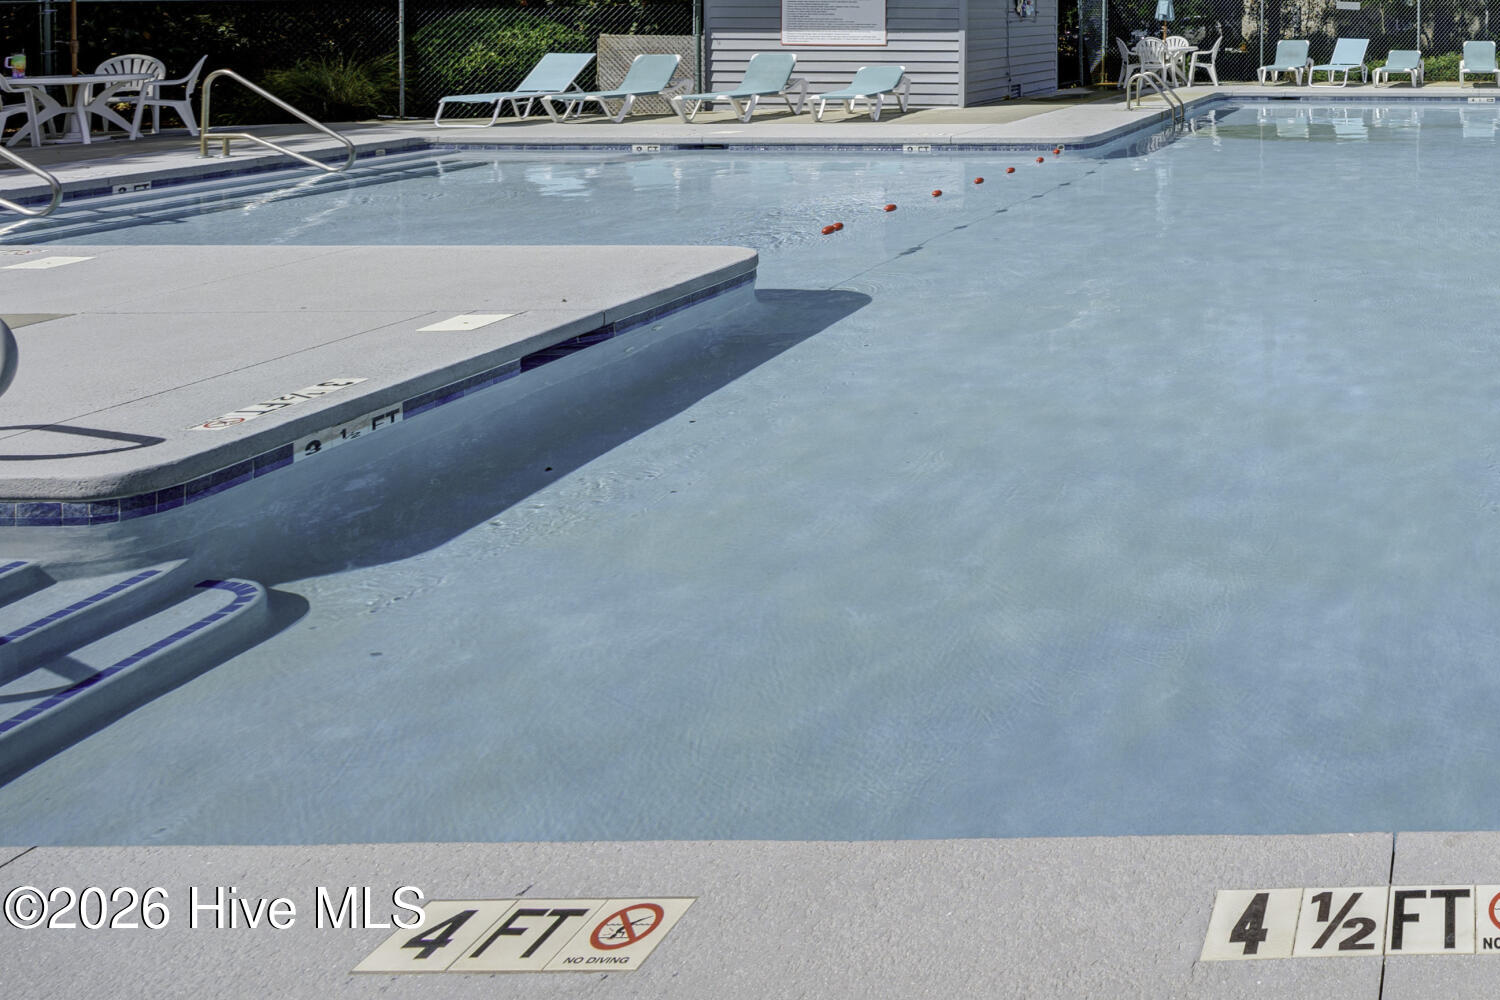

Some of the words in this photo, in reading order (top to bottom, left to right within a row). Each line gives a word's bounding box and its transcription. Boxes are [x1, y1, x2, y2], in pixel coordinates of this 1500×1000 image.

[371, 408, 400, 431] FT
[401, 910, 480, 960] 4
[469, 908, 591, 958] FT
[1229, 892, 1269, 955] 4
[1390, 889, 1471, 950] FT
[562, 956, 585, 965] NO
[585, 956, 631, 965] DIVING
